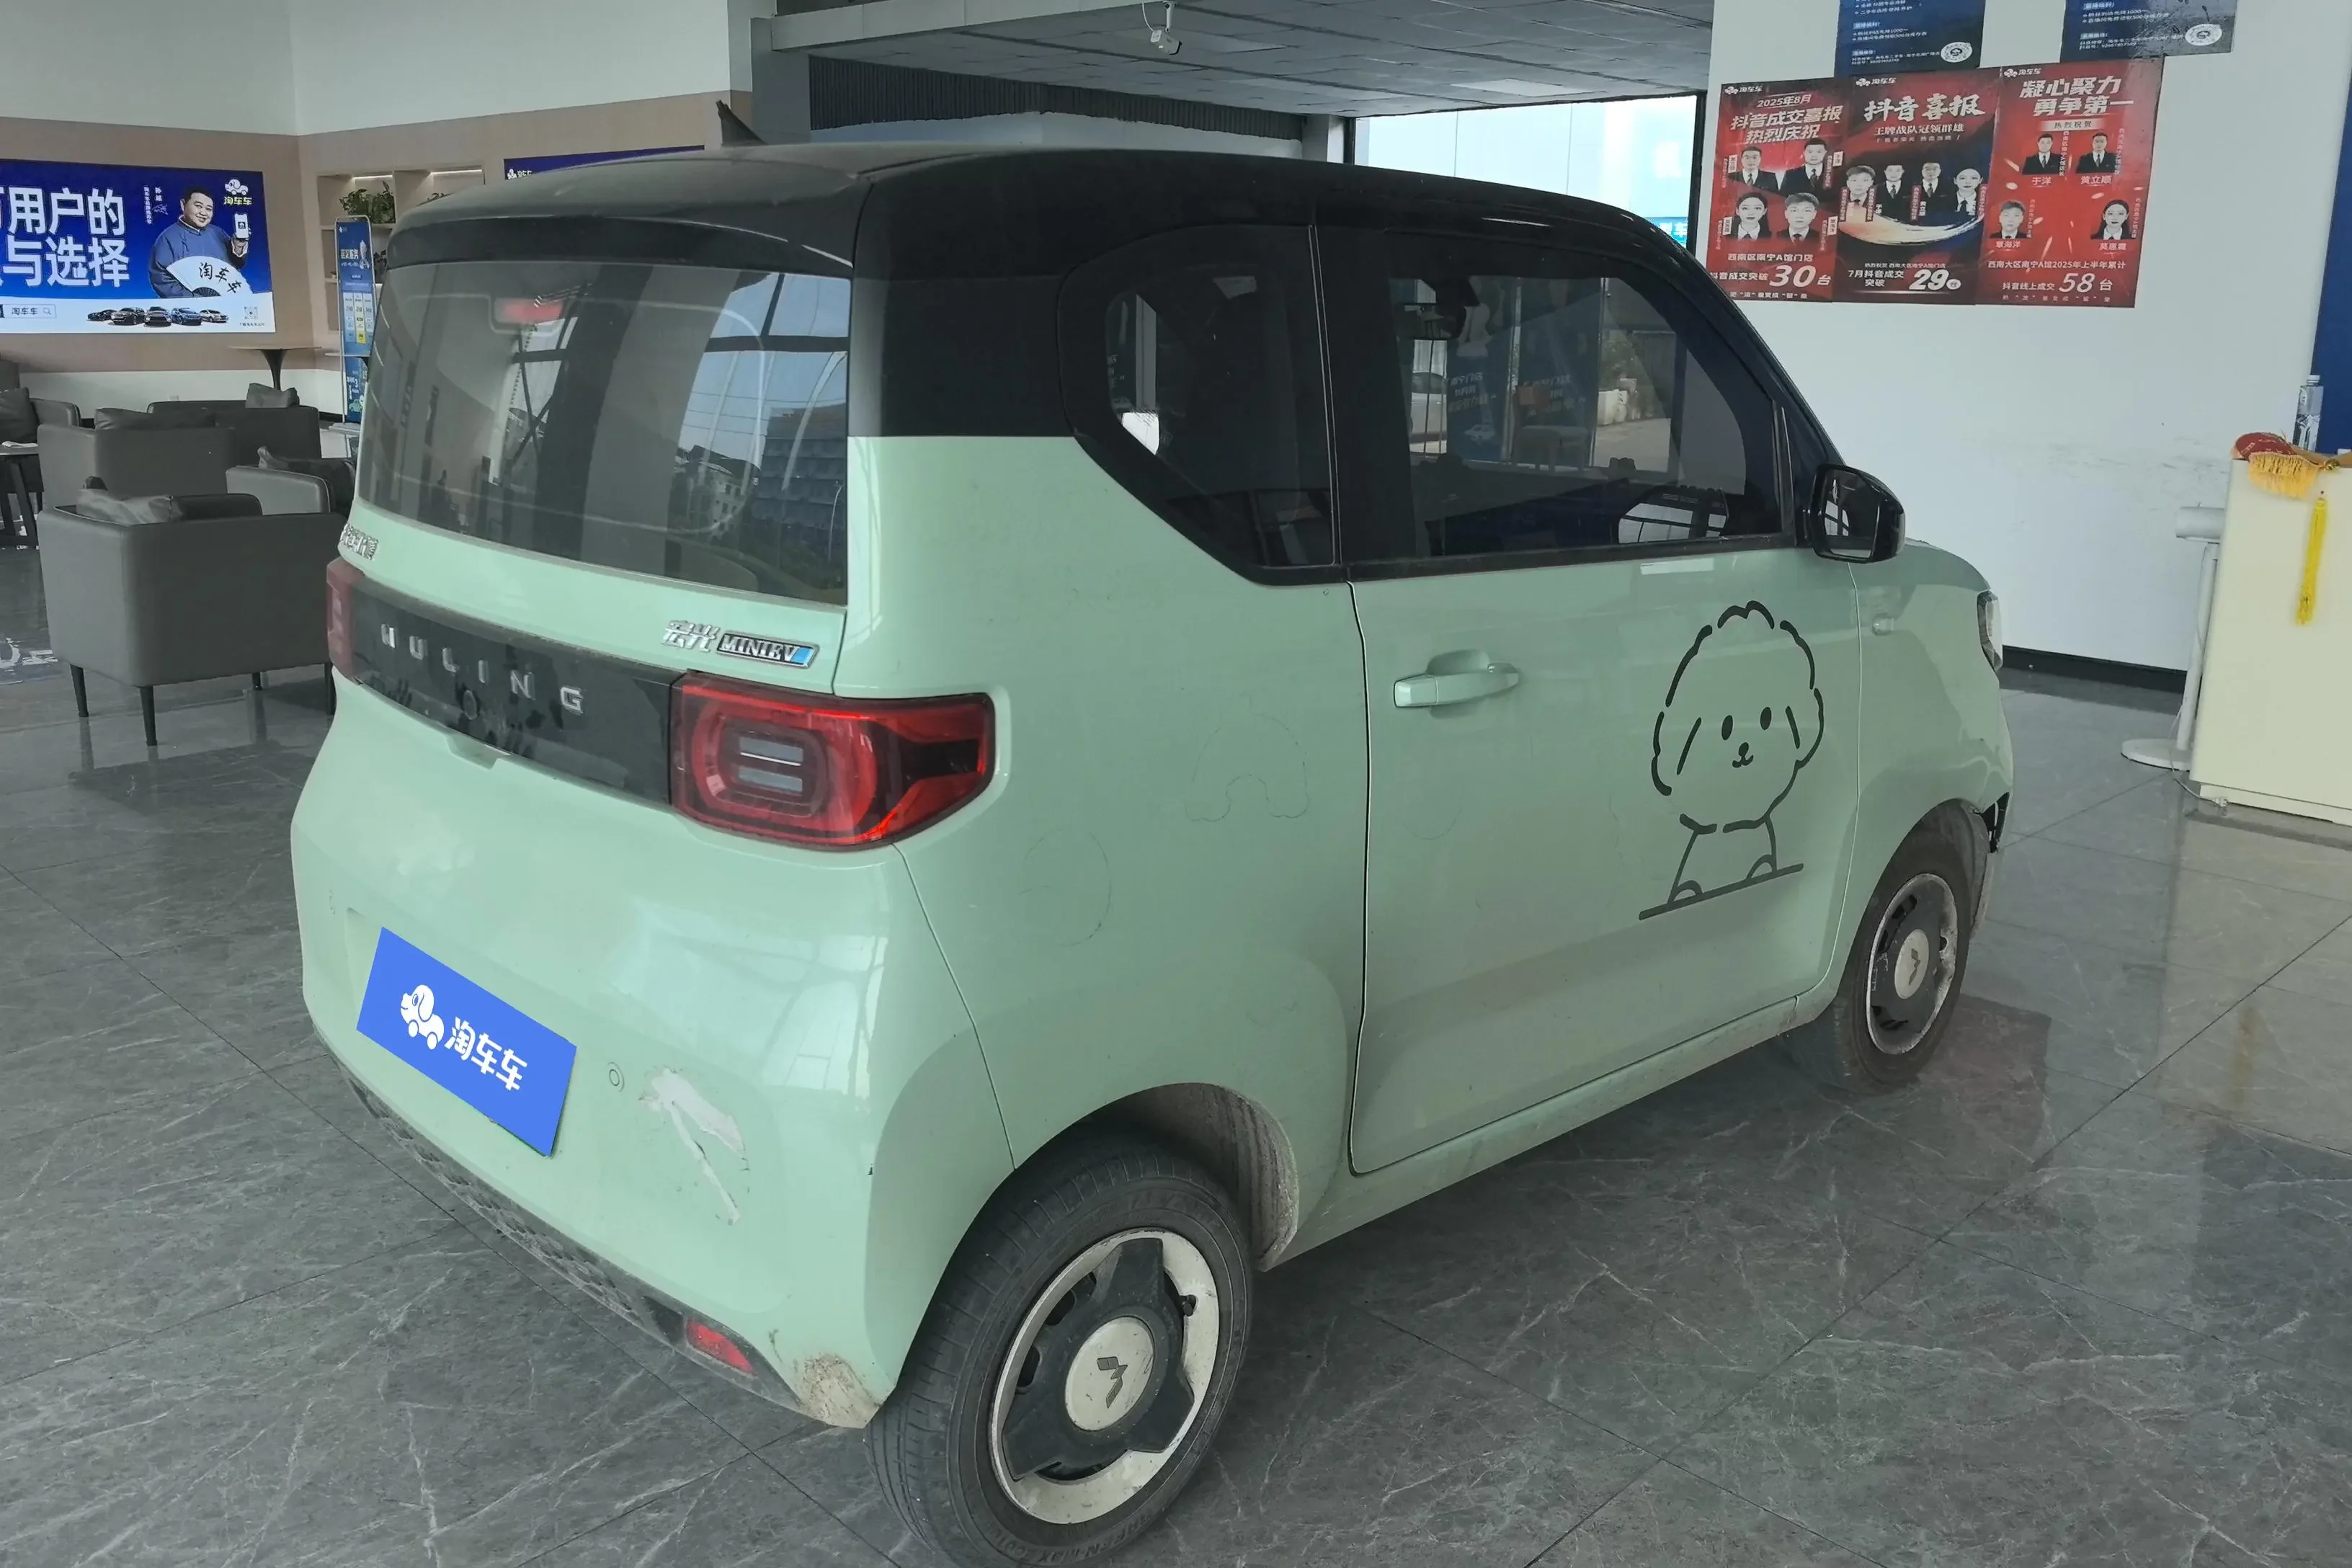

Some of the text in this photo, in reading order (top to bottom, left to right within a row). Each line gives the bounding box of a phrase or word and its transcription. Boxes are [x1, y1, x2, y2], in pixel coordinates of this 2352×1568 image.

[2019, 75, 2122, 98] 凝心聚力
[1756, 94, 1812, 108] 2025年8月
[2033, 95, 2134, 117] 勇争第一
[1730, 105, 1843, 130] 抖音成交喜报
[1745, 124, 1821, 145] 热烈庆祝
[2032, 176, 2052, 186] 于洋
[2080, 175, 2112, 185] 黄立顺
[0, 187, 125, 236] 用户的
[223, 196, 252, 206] 淘车车
[0, 235, 130, 288] 与选择
[1728, 253, 1813, 262] 西南区南宁A馆门店
[1769, 264, 1817, 288] 30
[1817, 275, 1832, 286] 台
[1848, 270, 1905, 279] 7月抖音成交
[1909, 269, 1950, 291] 29
[1864, 279, 1886, 288] 突破
[2058, 272, 2095, 293] 58
[2099, 279, 2113, 291] 台
[11, 307, 38, 316] 淘车车
[720, 634, 798, 662] MINIEV
[380, 623, 585, 716] WULING
